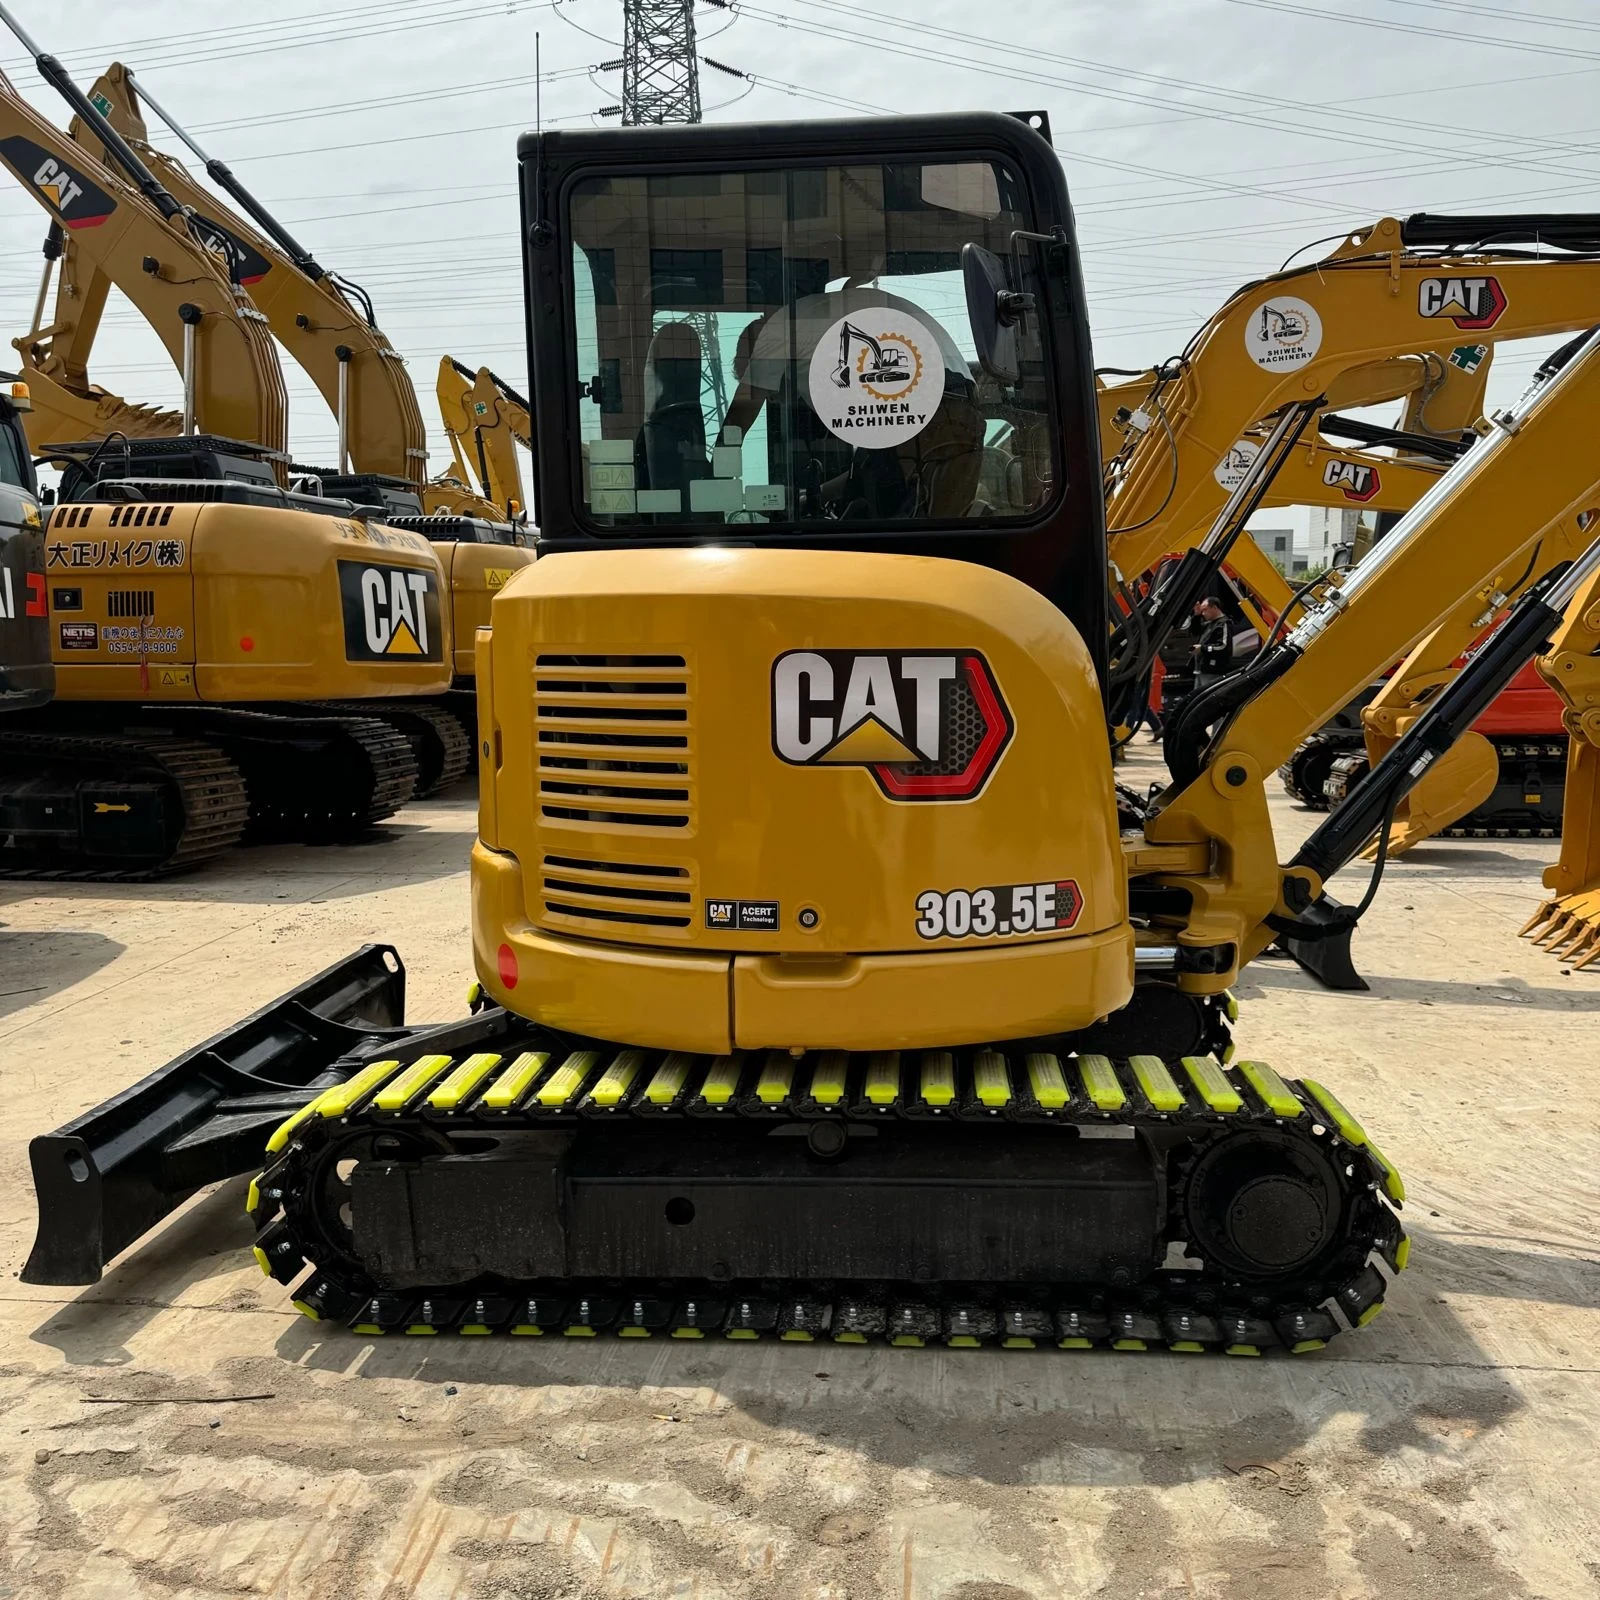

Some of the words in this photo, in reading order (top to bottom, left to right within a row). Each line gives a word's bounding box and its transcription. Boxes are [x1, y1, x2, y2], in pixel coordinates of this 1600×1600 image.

[33, 158, 84, 211] CAT
[1419, 278, 1487, 318] CAT
[1258, 351, 1314, 364] MACHINERY
[1267, 346, 1304, 357] SHIWEN
[832, 413, 927, 428] MACHINERY
[847, 402, 911, 416] SHIWEN
[1323, 460, 1372, 492] CAT
[360, 567, 429, 655] CAT
[63, 628, 96, 637] NETIS
[774, 651, 957, 762] CAT
[709, 904, 733, 918] CAT
[916, 883, 1057, 936] 303.5E
